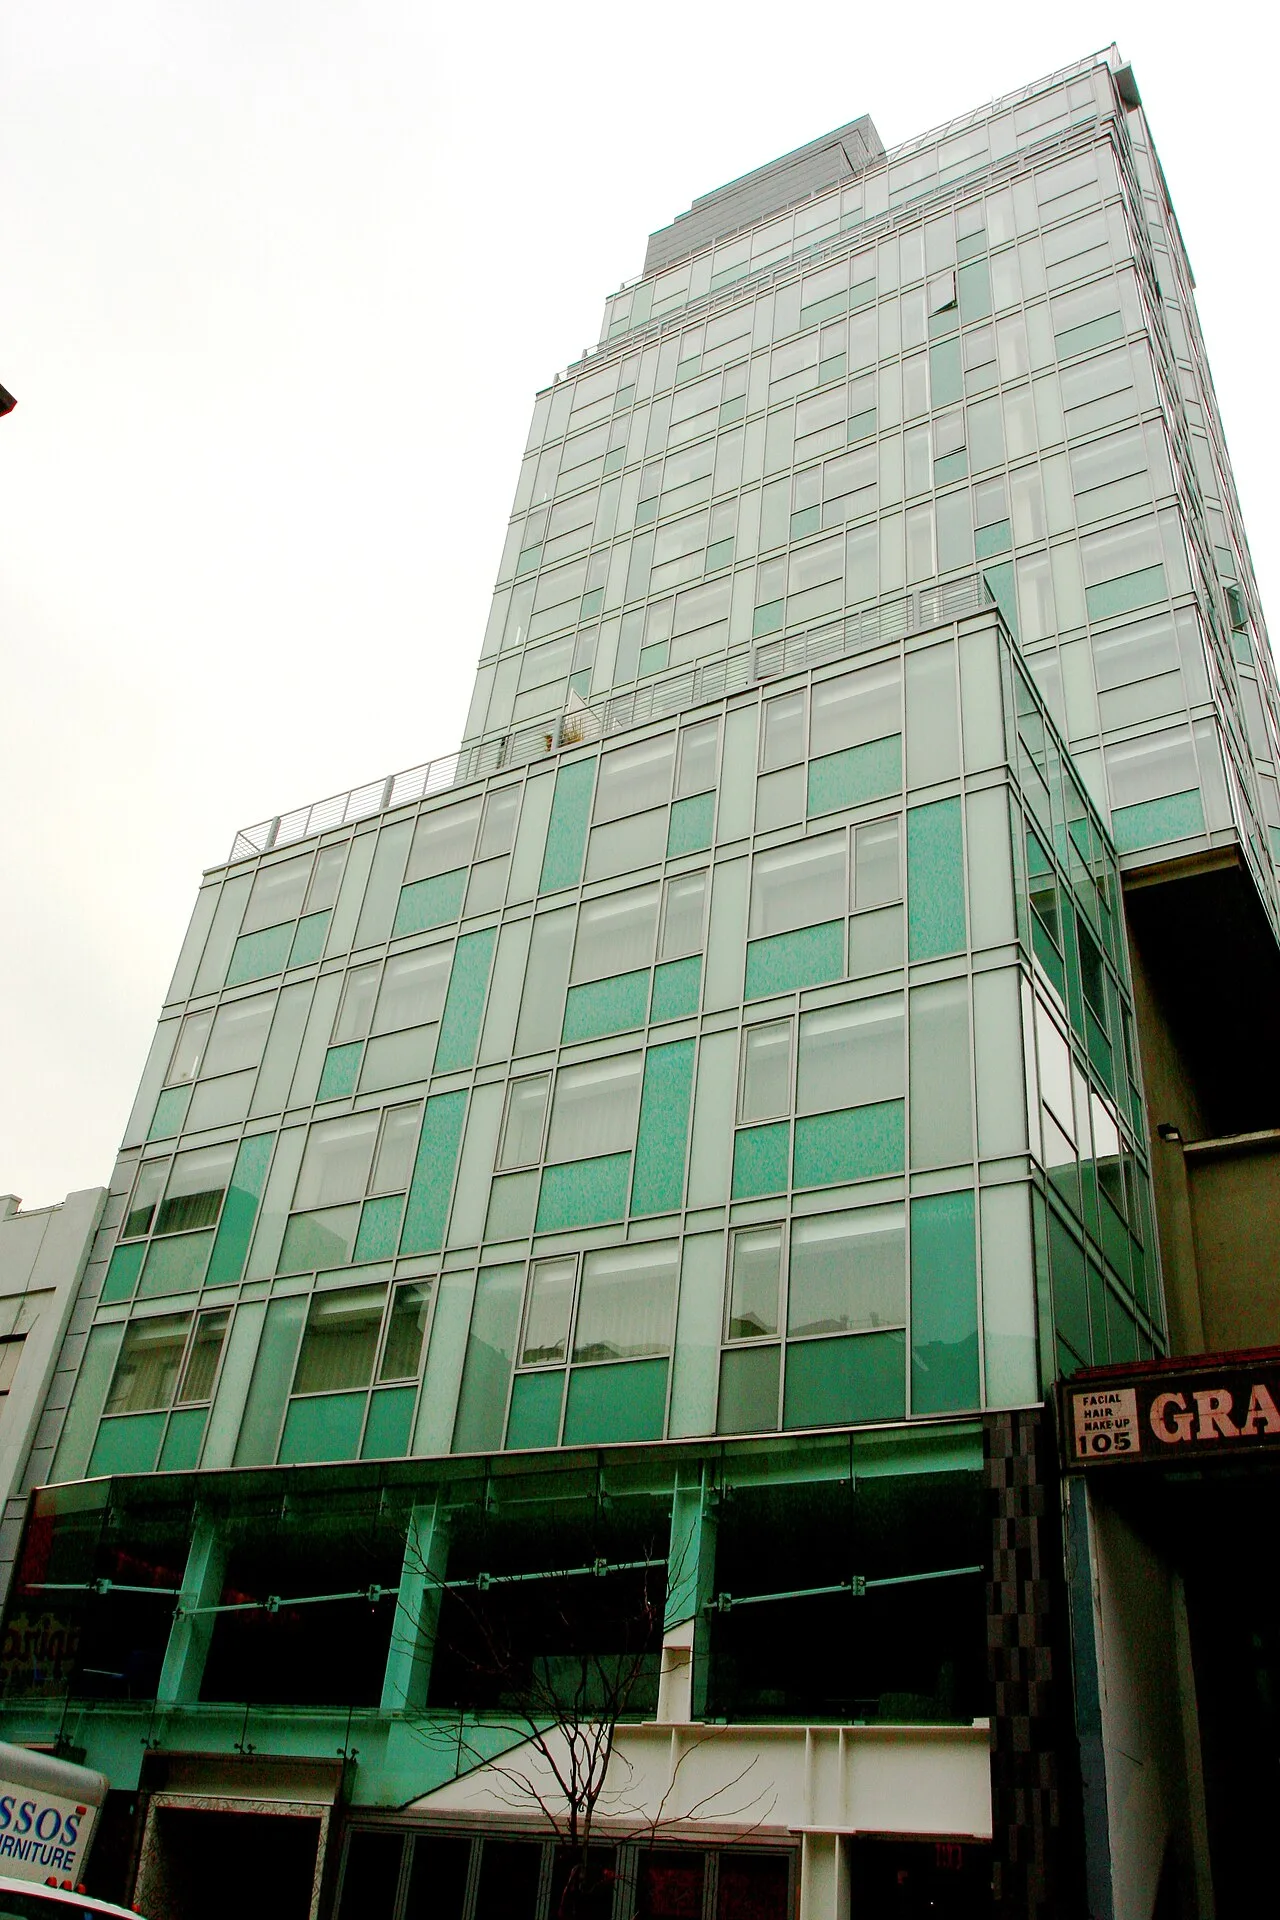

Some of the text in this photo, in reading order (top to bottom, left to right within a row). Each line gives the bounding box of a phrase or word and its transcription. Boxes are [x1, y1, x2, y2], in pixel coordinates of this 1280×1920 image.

[1083, 1394, 1121, 1406] FACIAL
[1084, 1408, 1113, 1418] HAIR
[1079, 1432, 1131, 1454] 105
[0, 1796, 82, 1847] SSOS
[0, 1833, 76, 1871] RNITURE
